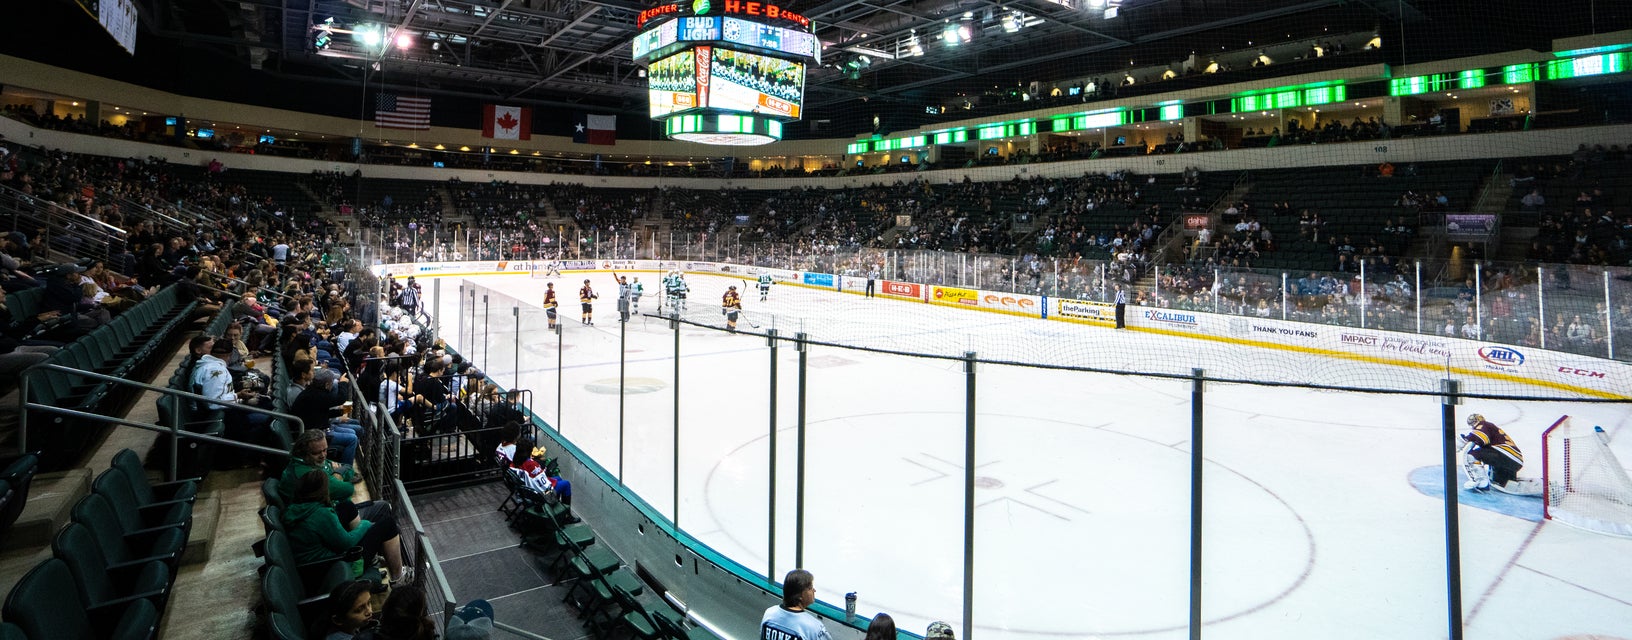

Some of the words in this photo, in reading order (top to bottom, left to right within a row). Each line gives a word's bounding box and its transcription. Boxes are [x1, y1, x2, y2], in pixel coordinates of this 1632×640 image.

[647, 4, 677, 17] CENTER
[725, 0, 780, 18] H-E-B
[686, 17, 714, 28] BUD
[683, 28, 717, 40] LIGHT
[1374, 145, 1388, 153] 108
[513, 261, 523, 271] at
[890, 285, 911, 294] H-E-B
[1145, 310, 1196, 323] EXCALIBUR
[1252, 325, 1277, 334] THANK
[1278, 327, 1294, 336] YOU
[1294, 329, 1318, 339] FANS!
[1341, 334, 1378, 346] IMPACT
[1381, 339, 1398, 351] for
[1399, 341, 1426, 355] local
[1487, 349, 1514, 360] AHL
[1558, 366, 1606, 379] CCM
[537, 476, 547, 486] 10
[765, 627, 799, 640] HONK
